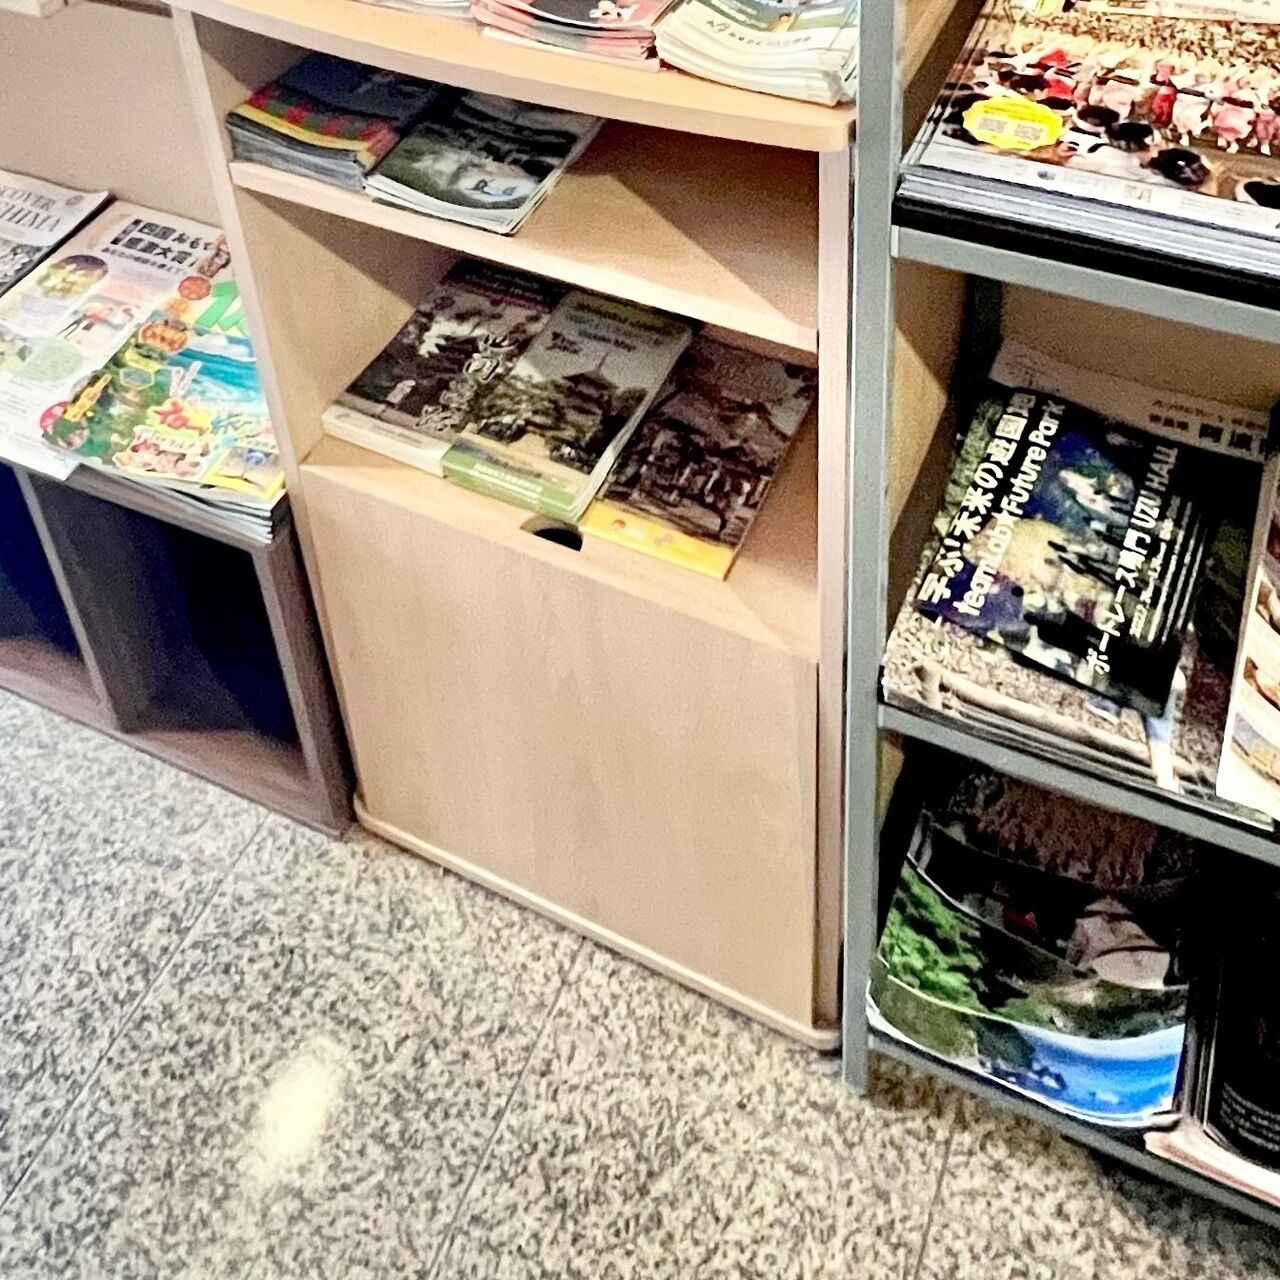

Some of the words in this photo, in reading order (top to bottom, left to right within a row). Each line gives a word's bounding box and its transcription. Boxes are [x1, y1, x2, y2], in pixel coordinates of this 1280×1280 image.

[1000, 445, 1047, 516] Future
[1028, 399, 1066, 448] Park
[1144, 445, 1179, 492] HALL
